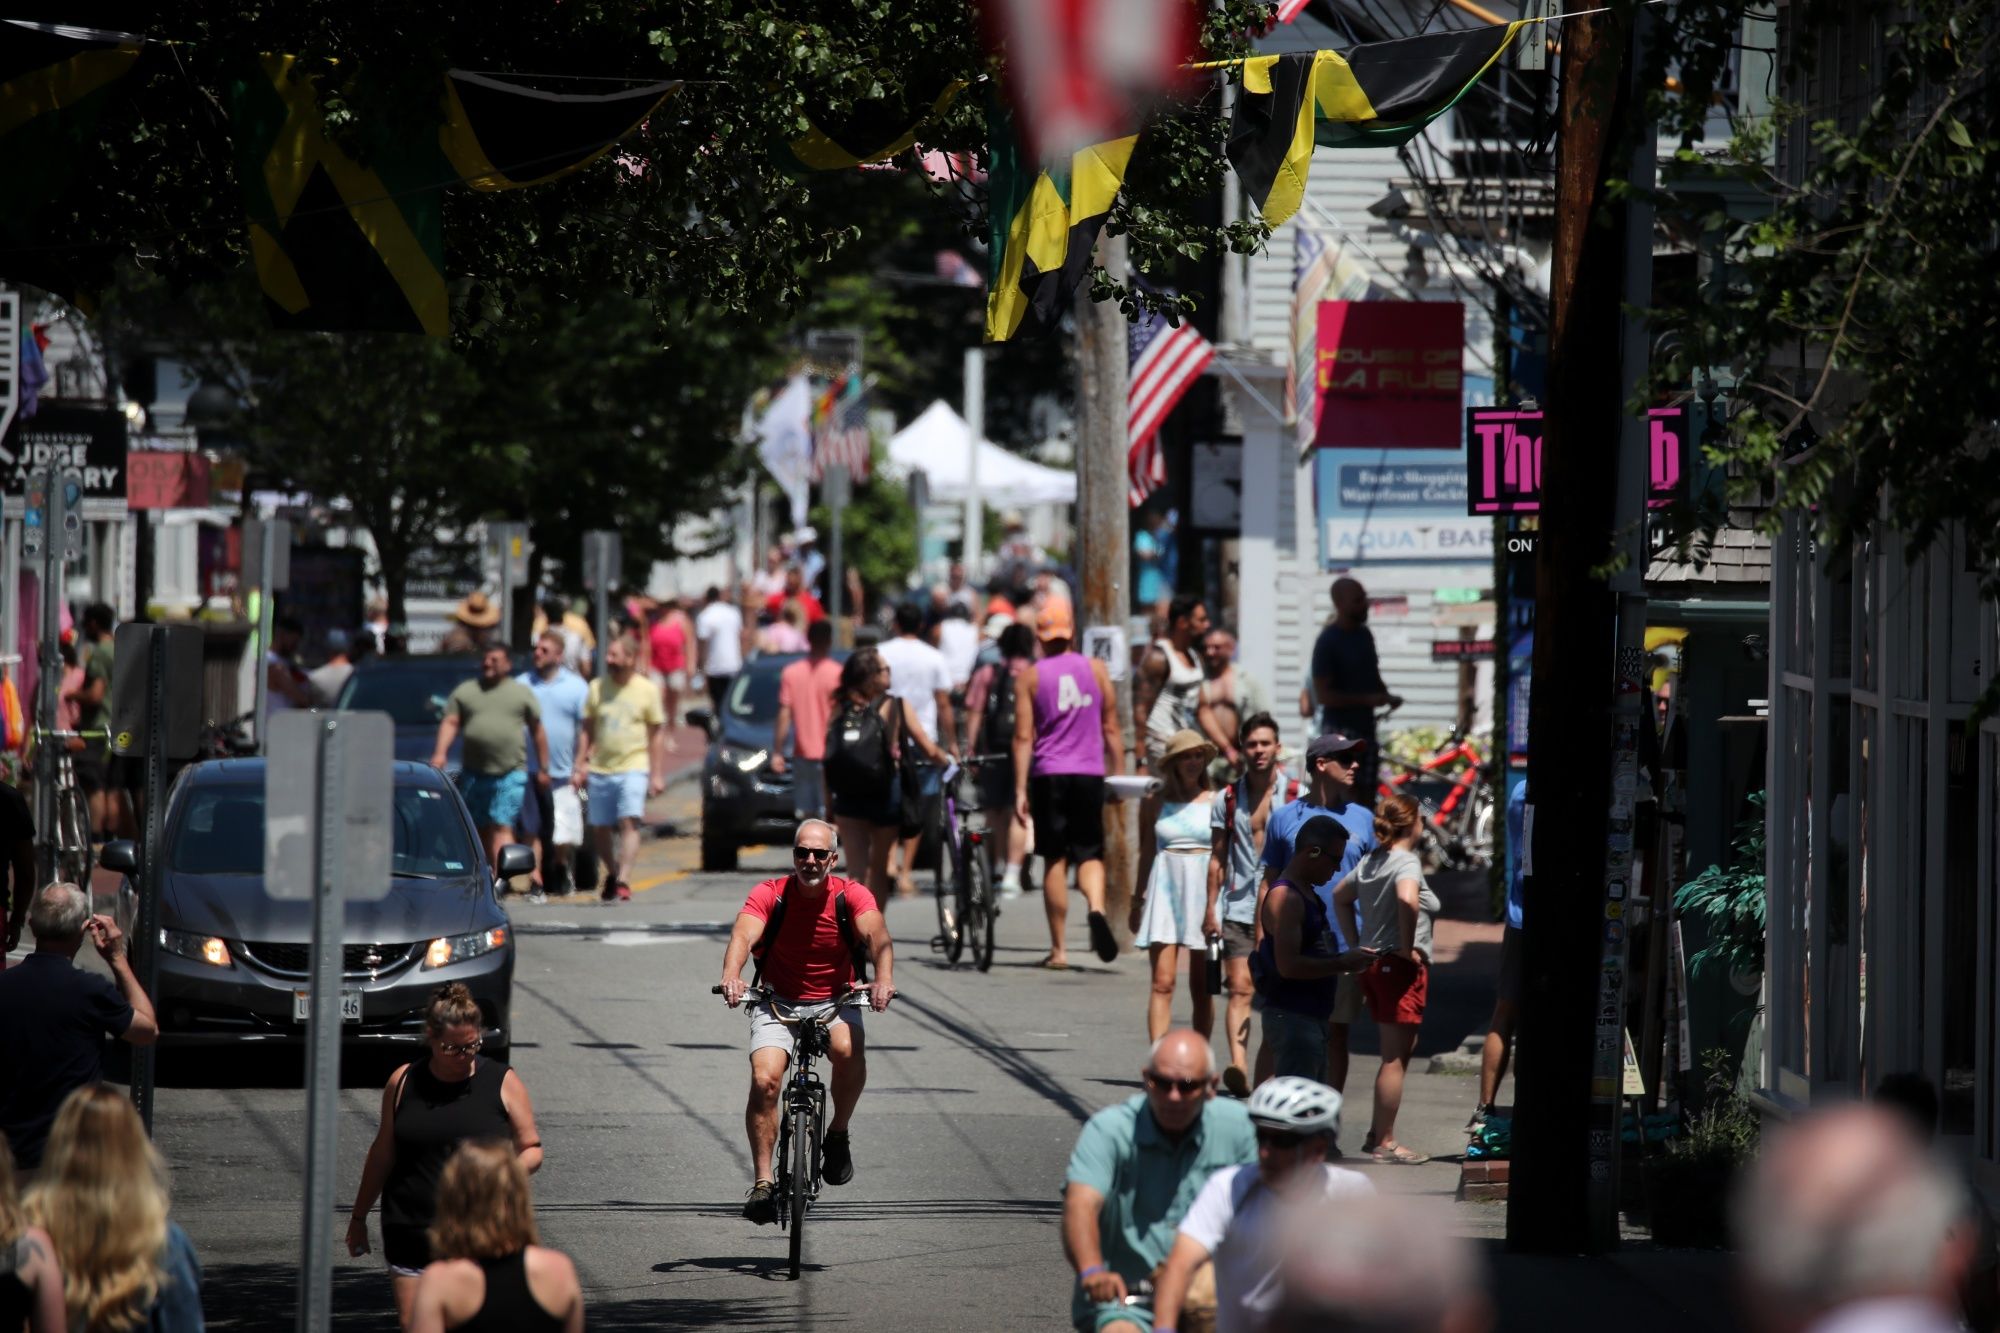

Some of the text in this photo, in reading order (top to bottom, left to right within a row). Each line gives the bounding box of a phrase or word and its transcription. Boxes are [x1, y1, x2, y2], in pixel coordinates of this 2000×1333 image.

[1319, 348, 1460, 363] HOUSE OF
[1318, 368, 1460, 389] LA RUE
[1338, 531, 1415, 550] AQUA
[1507, 538, 1532, 552] ON
